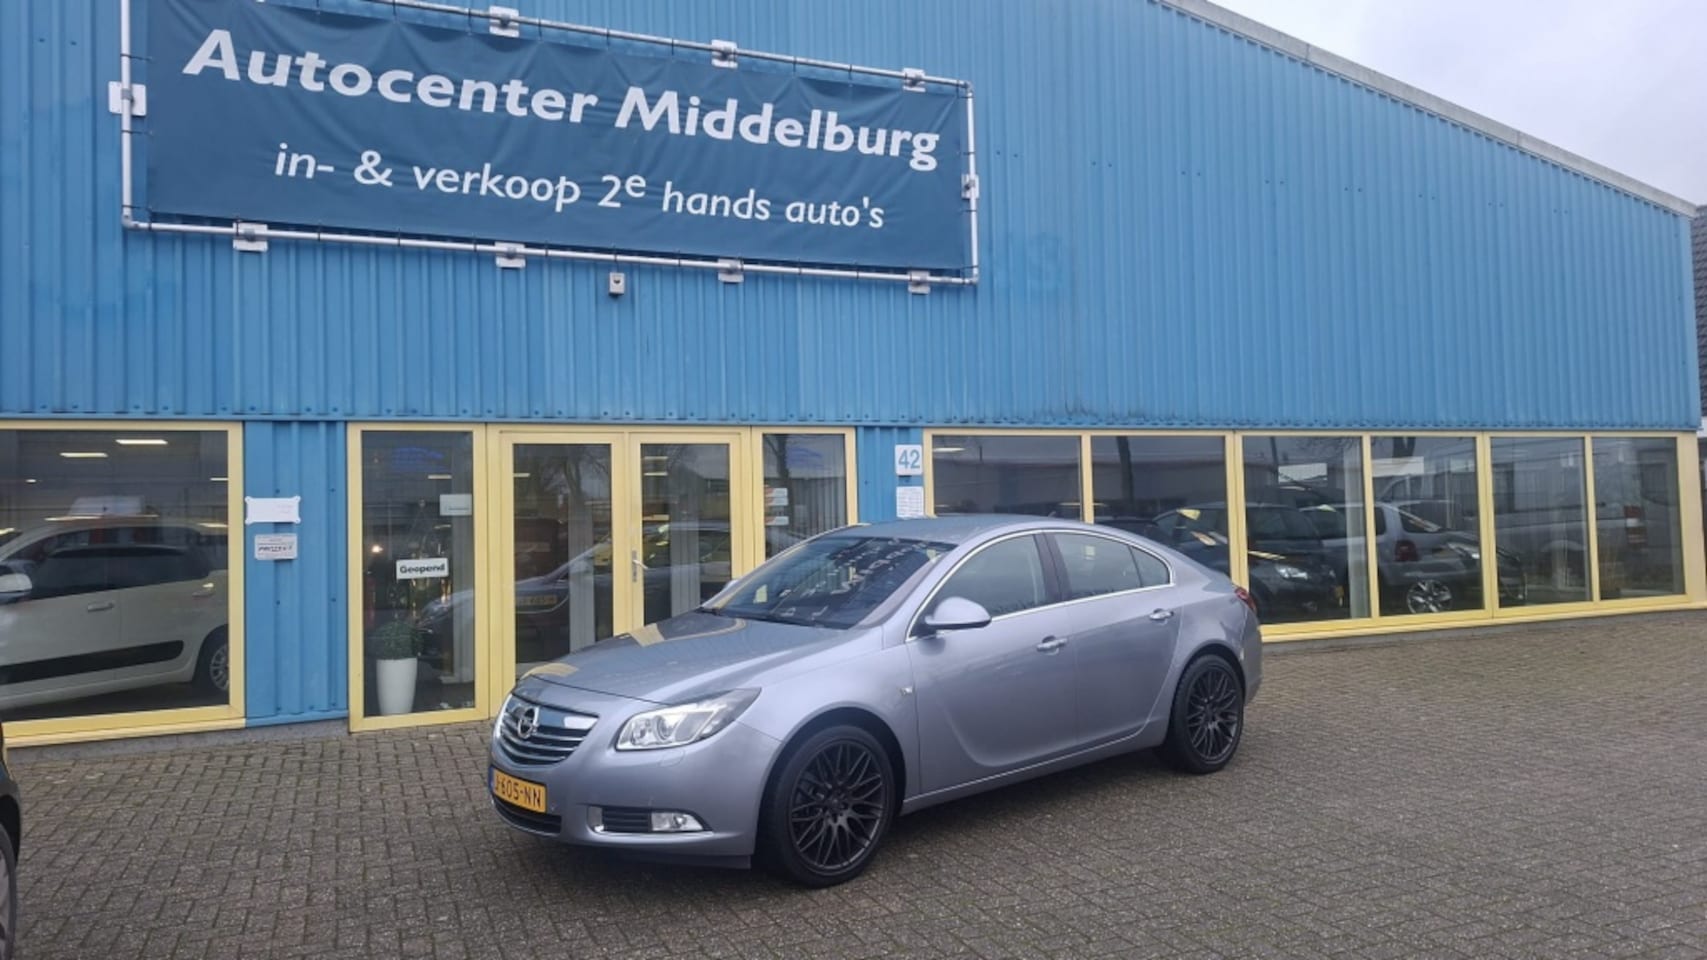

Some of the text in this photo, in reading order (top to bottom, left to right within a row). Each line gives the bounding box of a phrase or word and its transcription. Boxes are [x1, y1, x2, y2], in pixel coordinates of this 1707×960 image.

[182, 28, 940, 171] Autocenter Middelburg
[274, 142, 335, 179] in-
[354, 149, 393, 187] &
[413, 163, 581, 213] verkoop
[661, 181, 772, 221] hands
[785, 196, 885, 228] auto's
[898, 449, 921, 469] 42
[400, 563, 445, 574] Geopend
